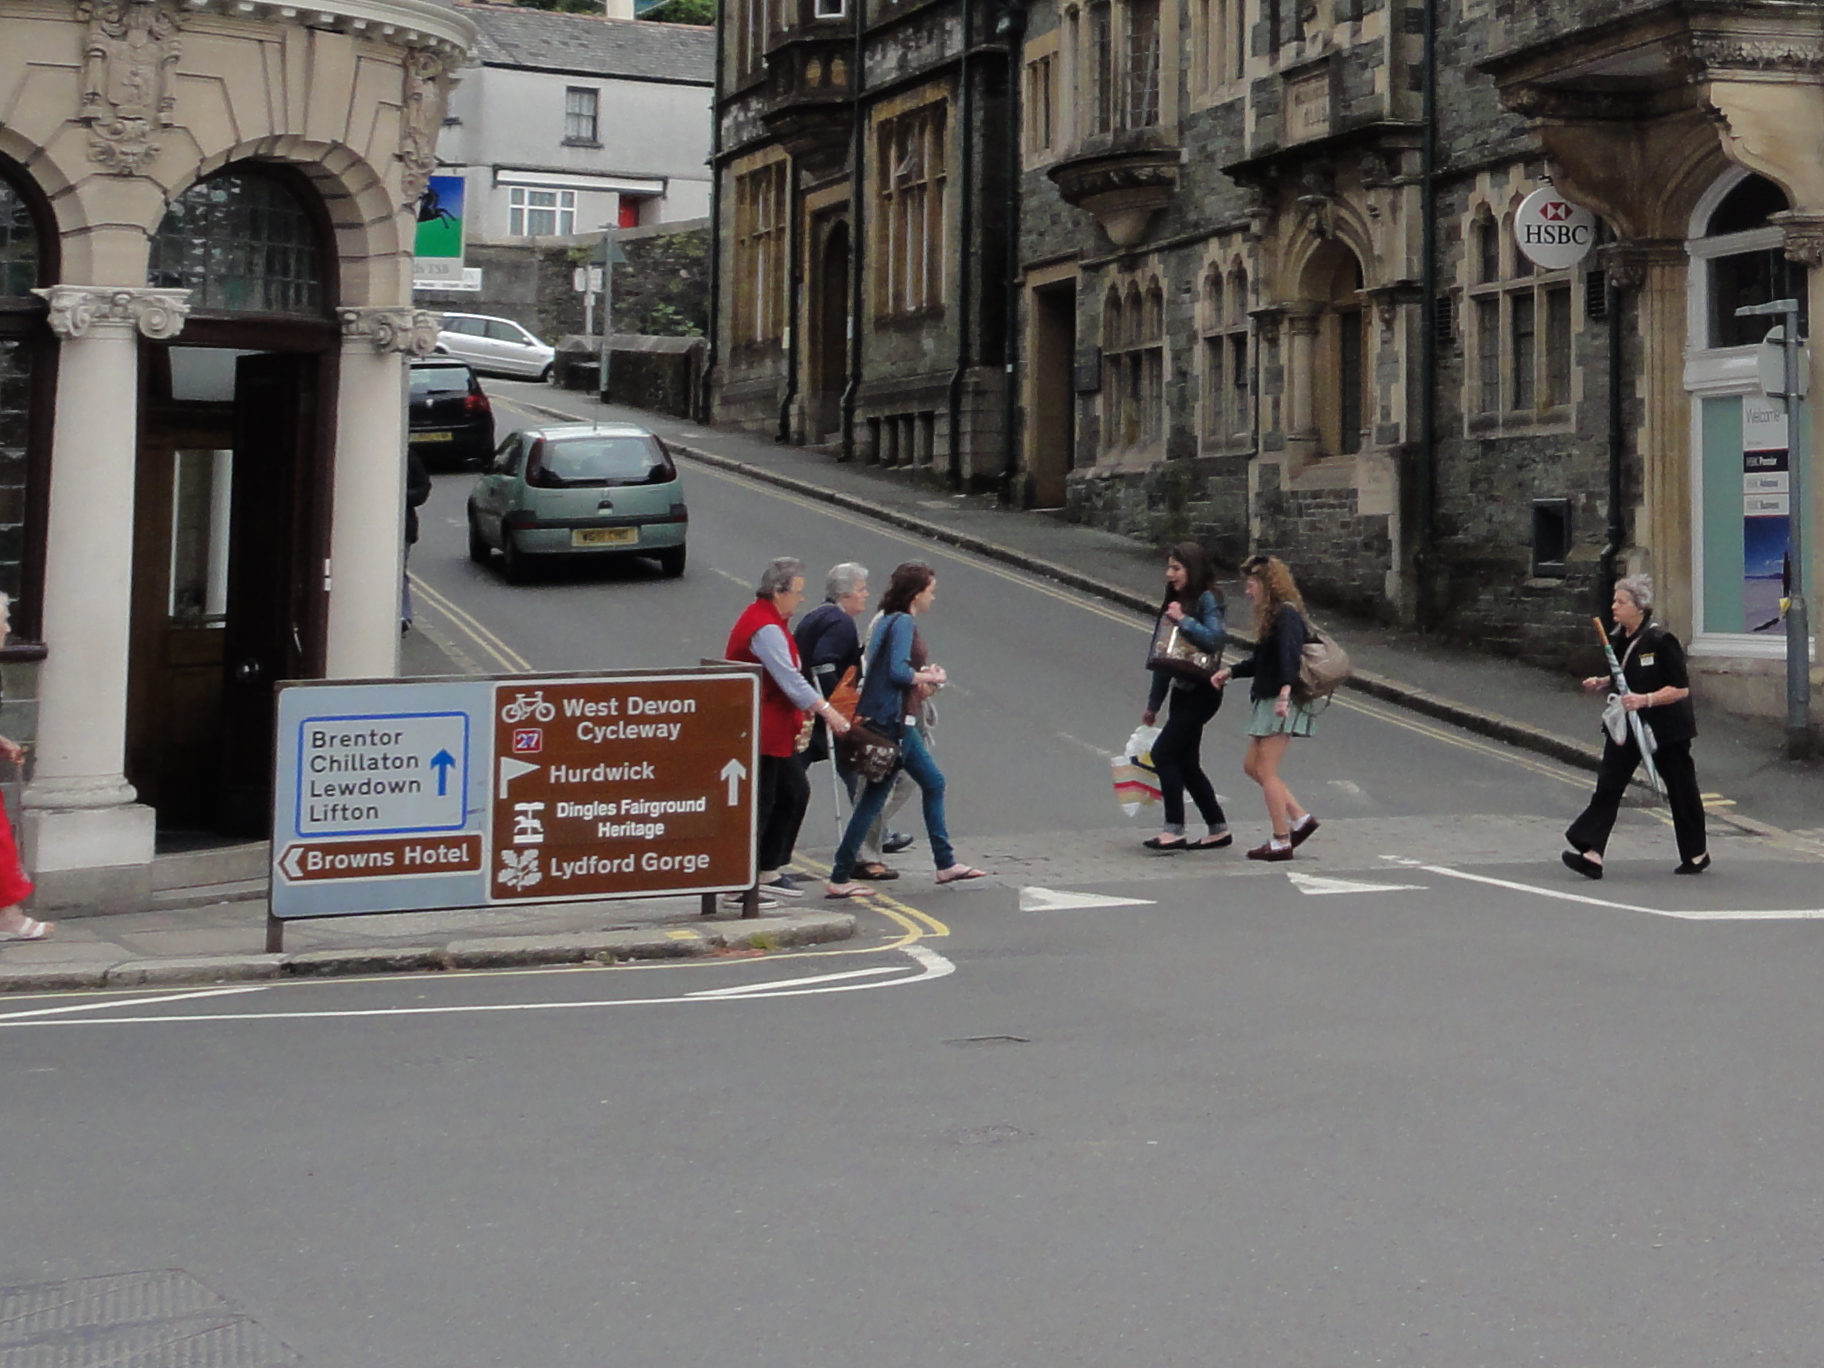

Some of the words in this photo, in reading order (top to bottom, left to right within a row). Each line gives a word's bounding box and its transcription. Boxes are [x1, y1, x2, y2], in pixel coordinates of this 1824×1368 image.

[1524, 224, 1589, 245] HSBC
[563, 698, 618, 717] West
[627, 696, 696, 715] Devon
[312, 729, 404, 748] Brentor
[515, 733, 540, 749] 27
[577, 721, 681, 743] Cycleway
[310, 753, 419, 773] Chillaton
[550, 761, 655, 783] Hurdwick
[310, 778, 421, 798] Lewdown
[309, 804, 379, 822] Lifton
[556, 801, 617, 820] Dingles
[620, 797, 706, 817] Fairground
[598, 821, 665, 839] Heritage
[307, 850, 395, 871] Browns
[404, 843, 470, 864] Hotel
[551, 854, 635, 879] Lydford
[641, 852, 710, 873] Gorge
